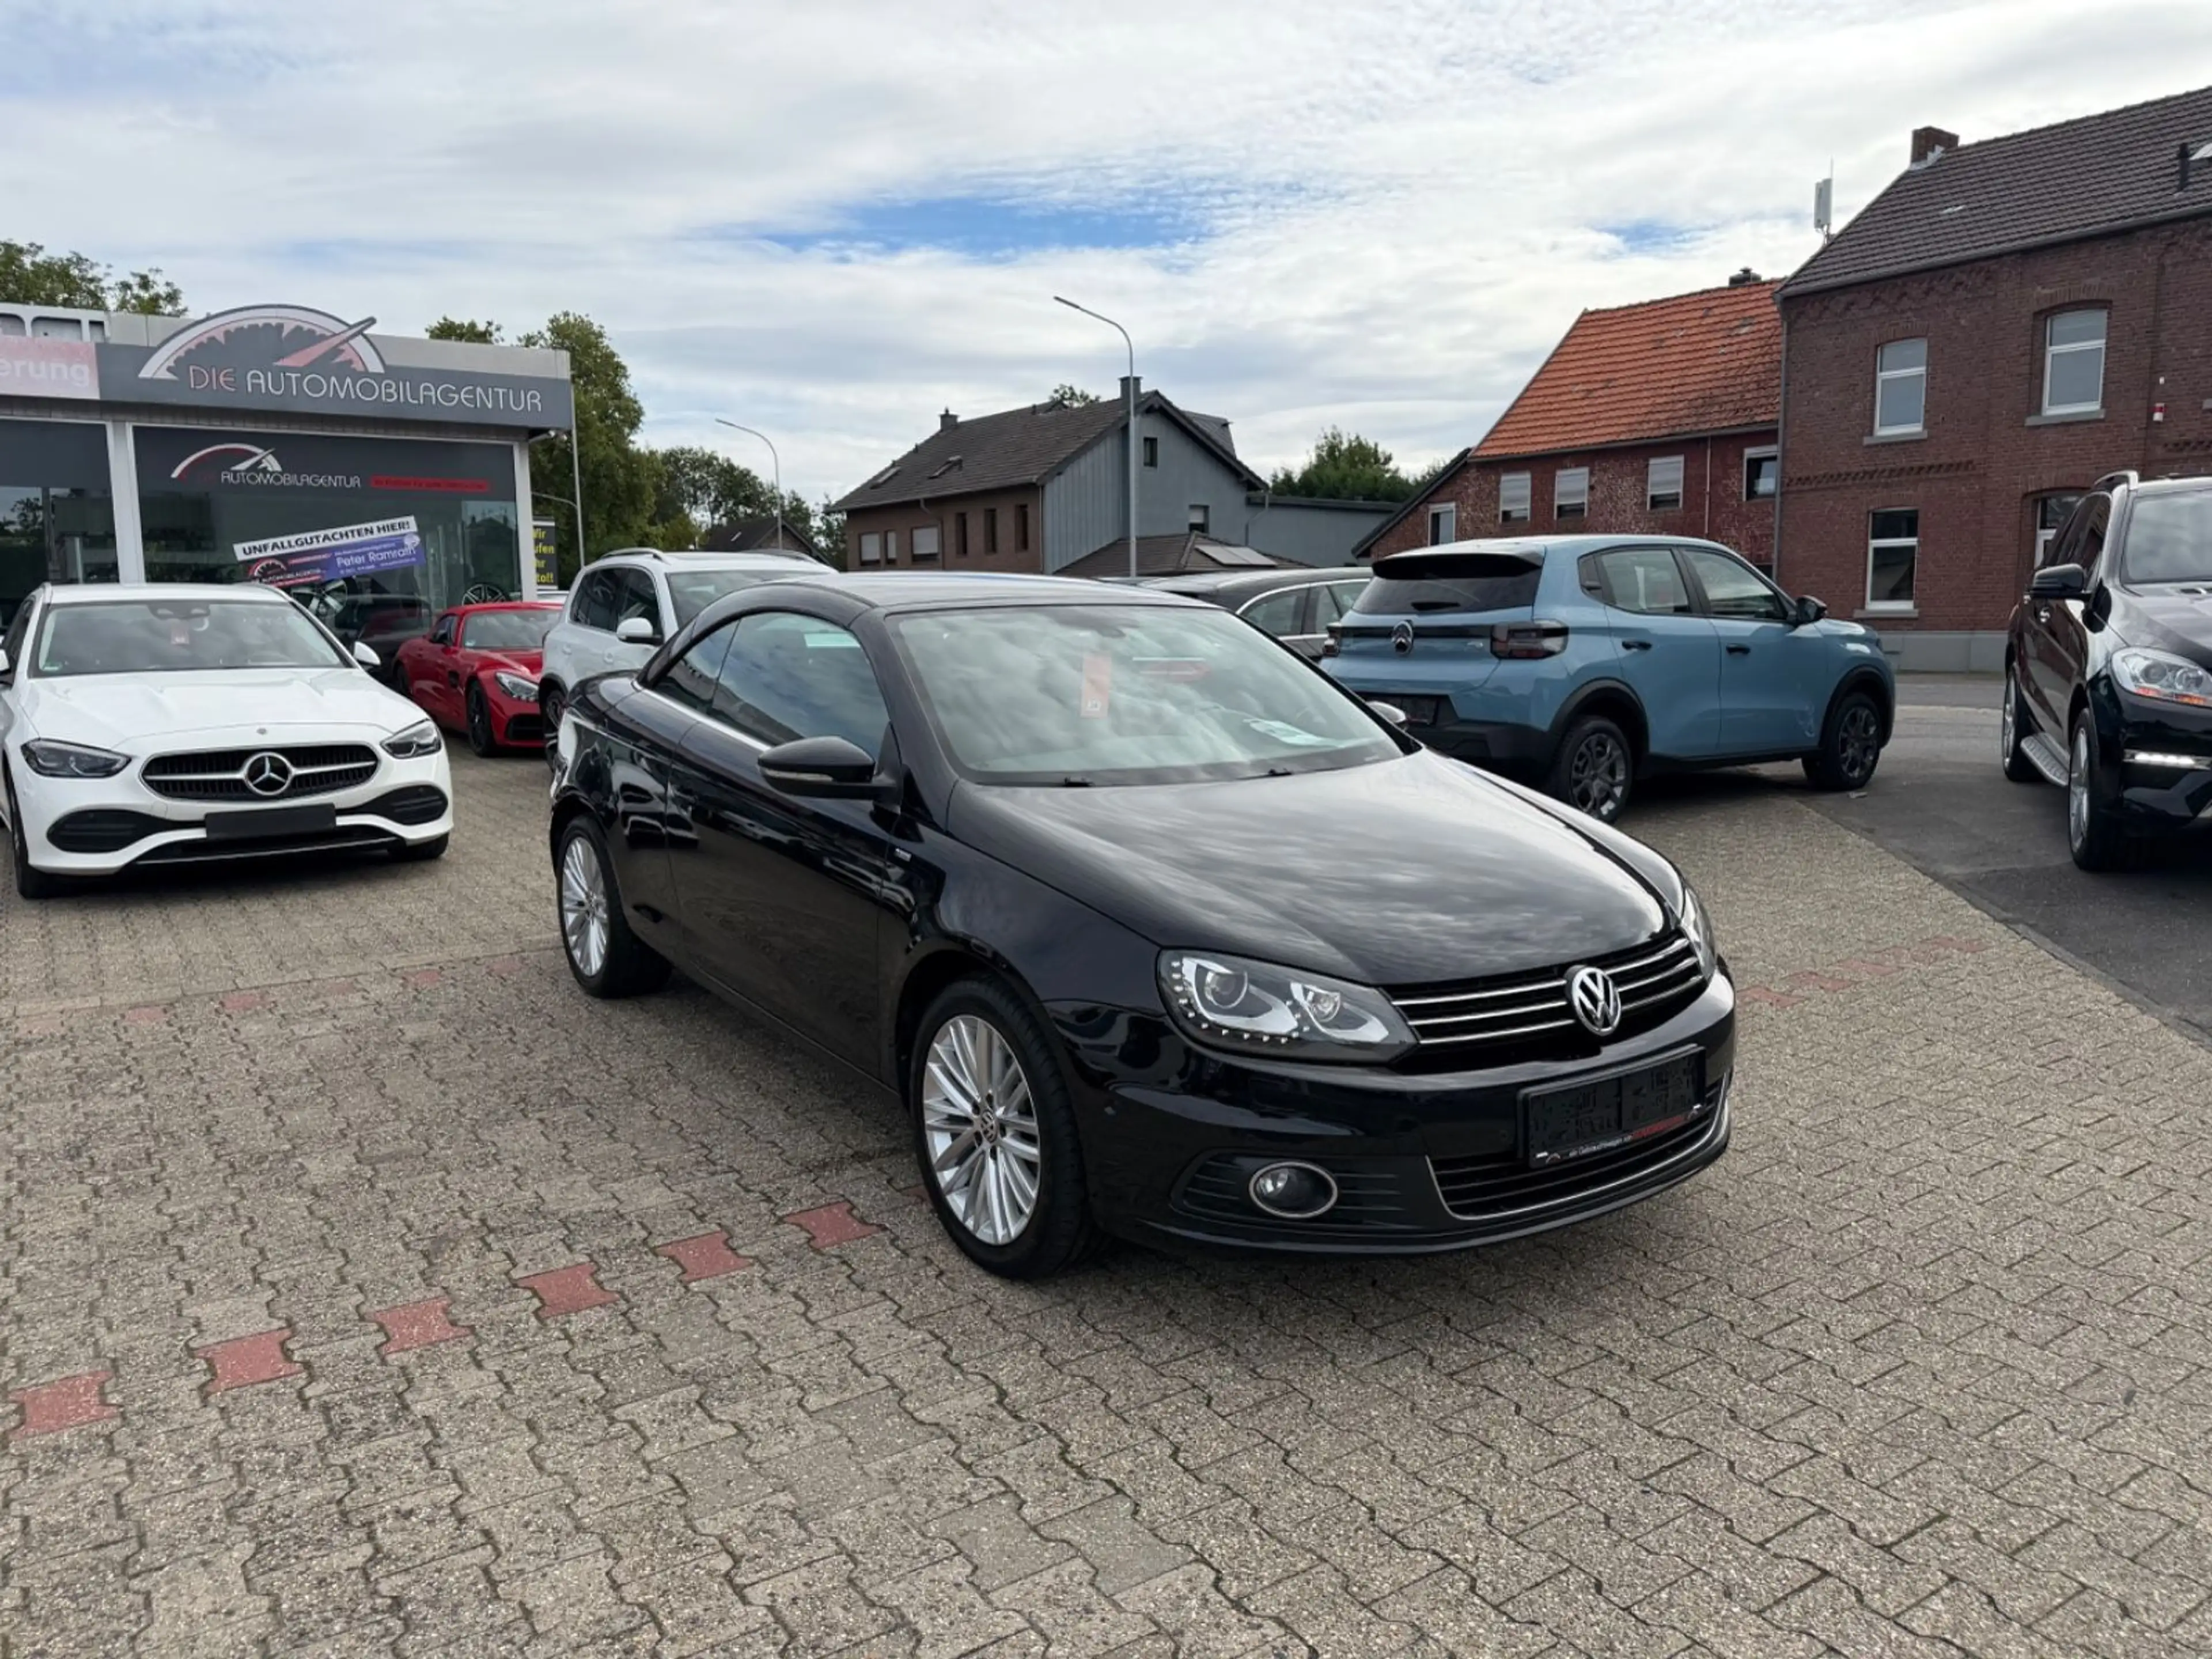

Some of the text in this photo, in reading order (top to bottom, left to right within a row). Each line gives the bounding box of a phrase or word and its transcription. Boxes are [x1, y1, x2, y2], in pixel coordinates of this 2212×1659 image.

[189, 364, 543, 412] DIE AUTOMOBILAGENTUR
[221, 470, 361, 488] AUTOMOBILAGENTUR
[242, 525, 374, 556] UNFALLGUTACHTEN
[377, 520, 411, 534] HIER!
[336, 555, 366, 568] Peter
